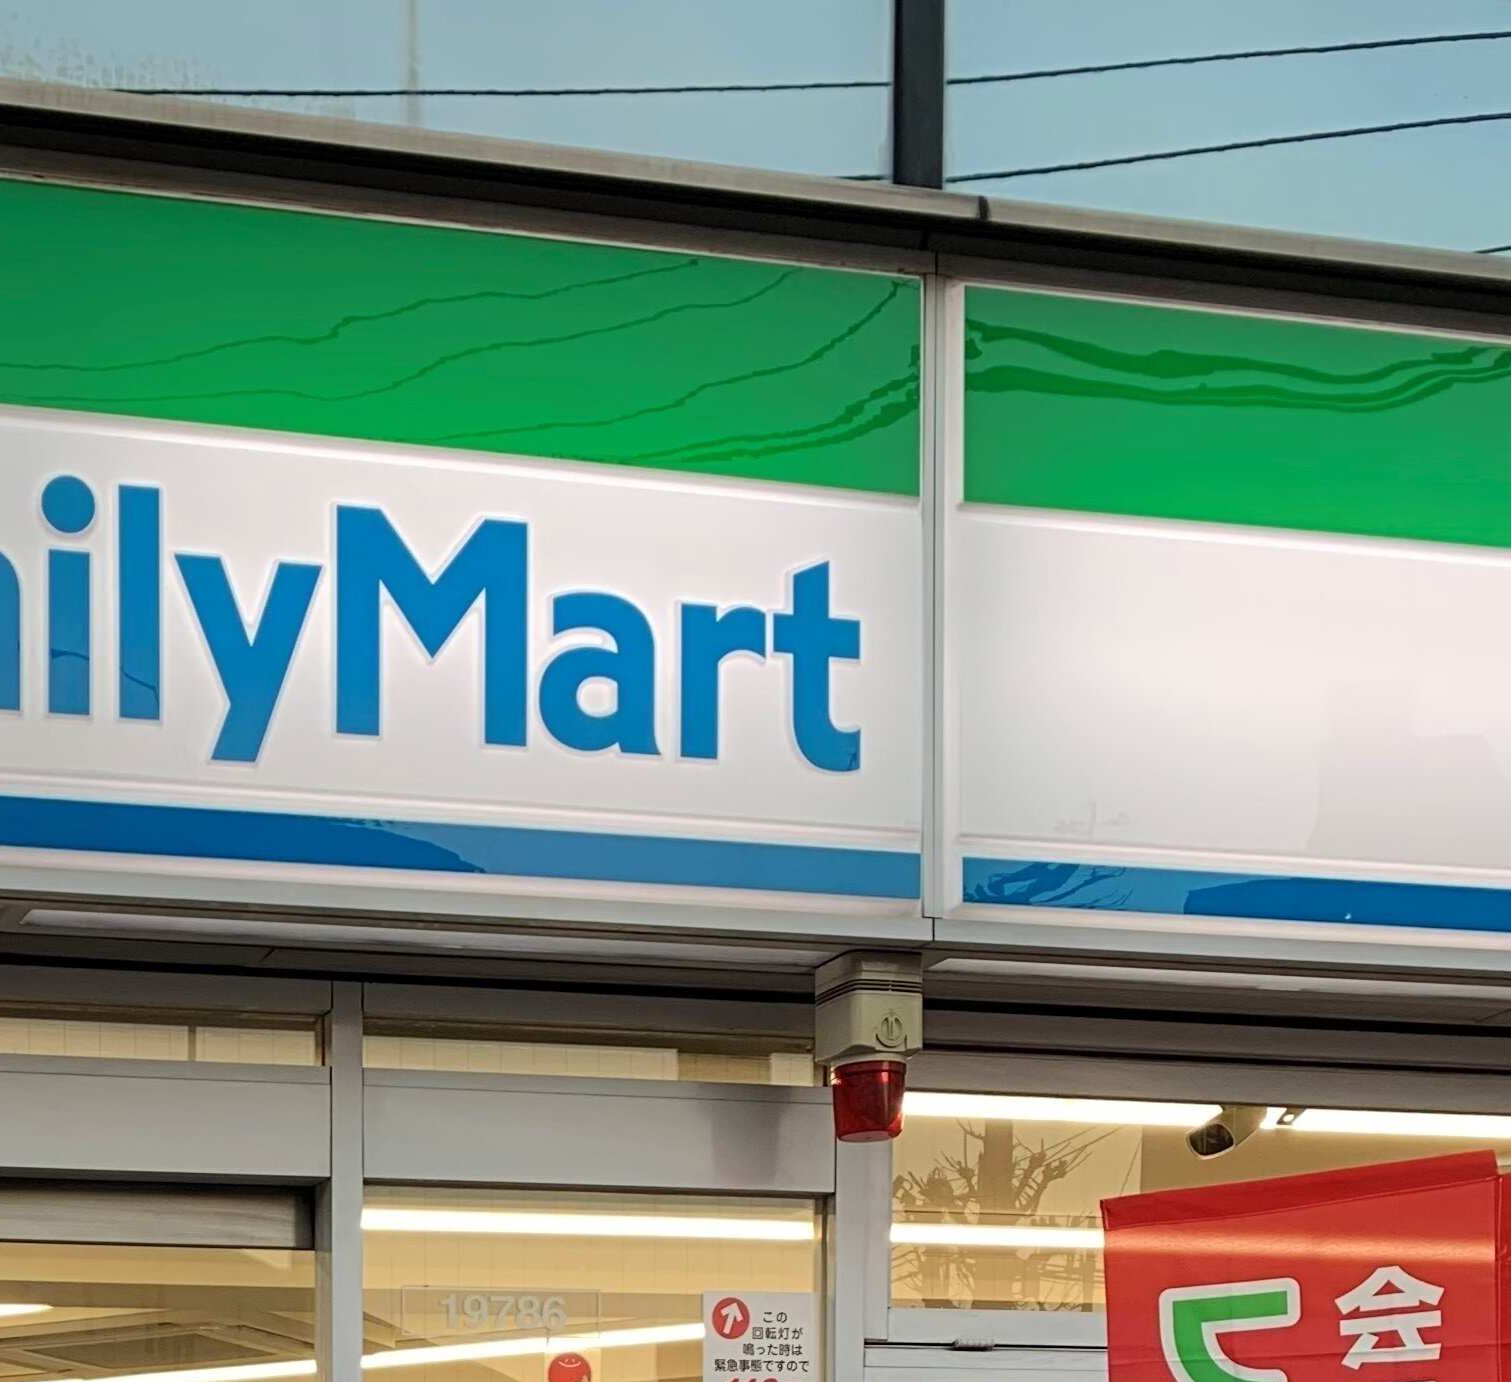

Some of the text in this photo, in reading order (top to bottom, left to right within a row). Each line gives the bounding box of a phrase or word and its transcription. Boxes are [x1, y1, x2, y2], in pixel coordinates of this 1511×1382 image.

[441, 1293, 568, 1331] 19786
[763, 1311, 788, 1323] この
[752, 1327, 803, 1340] 回転灯が
[742, 1343, 803, 1357] 鳴った時は
[714, 1359, 809, 1372] 緊急事態ですので
